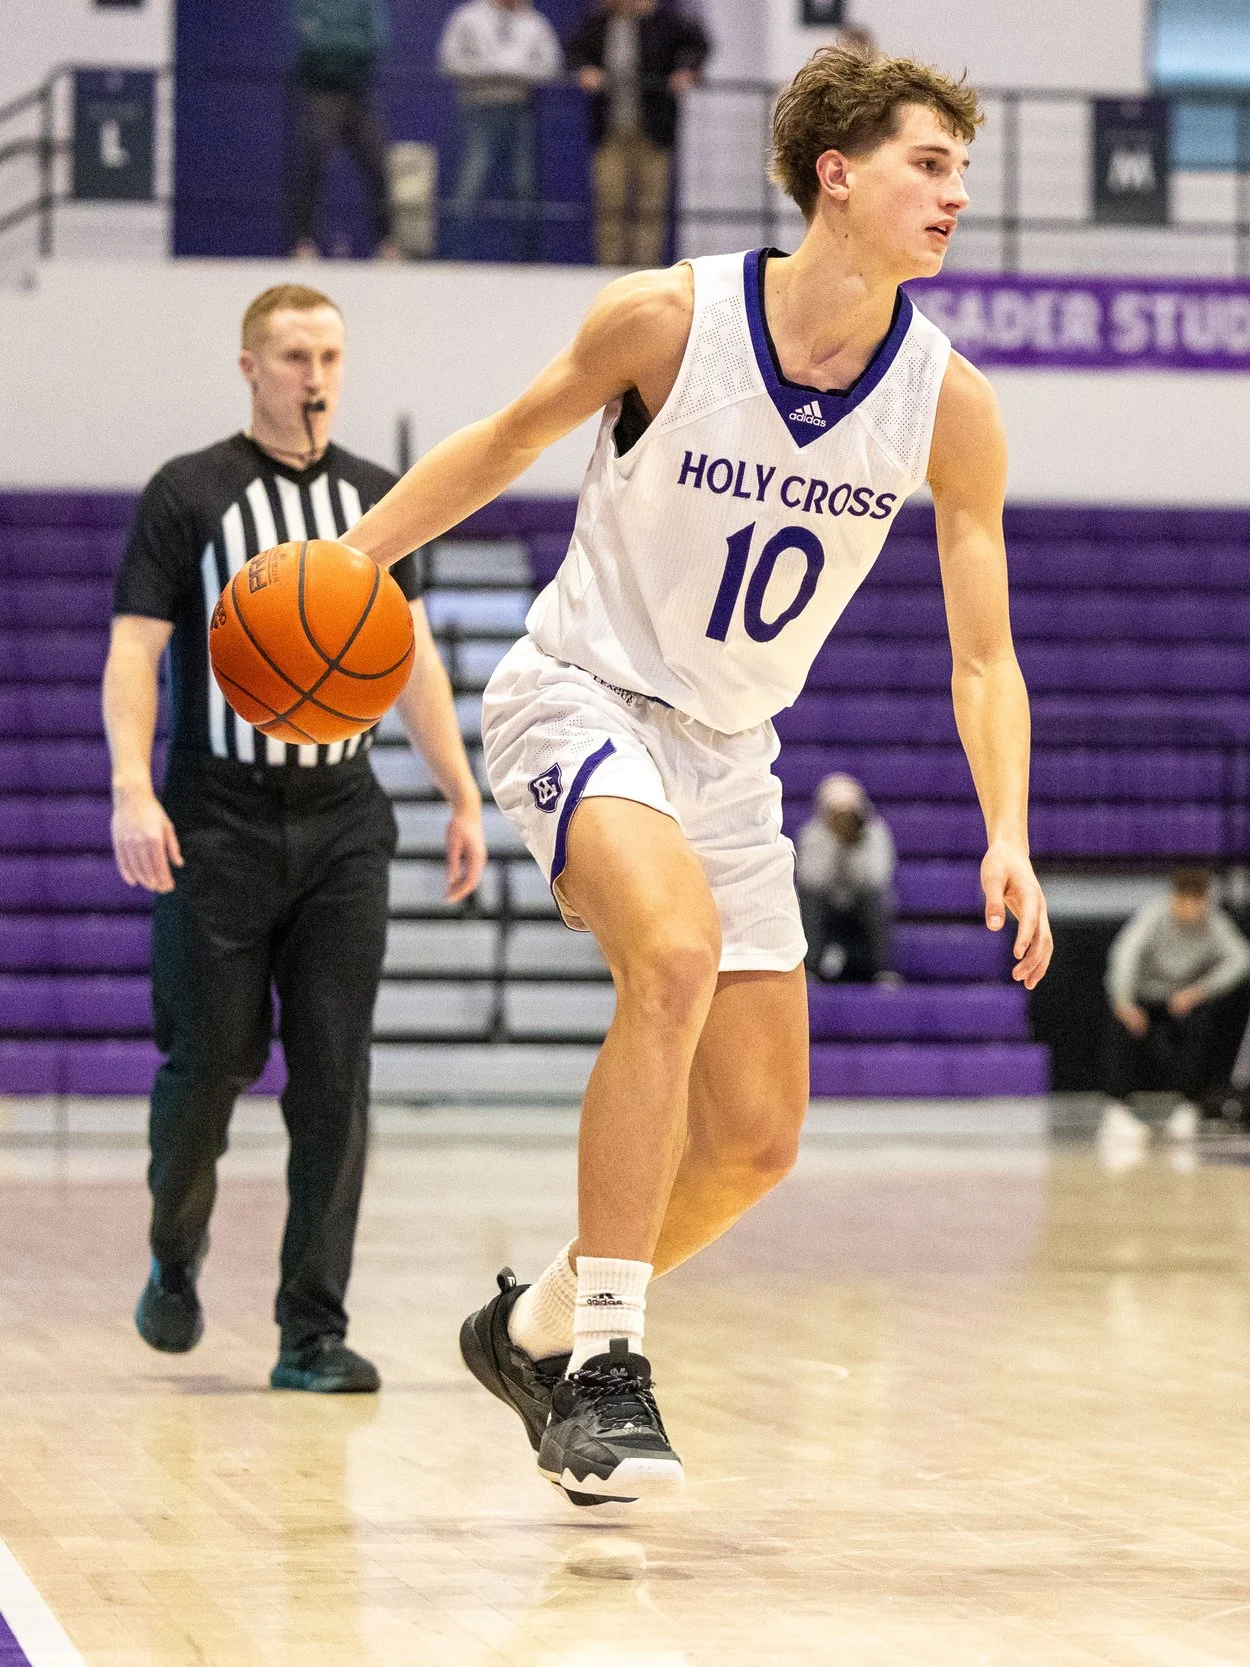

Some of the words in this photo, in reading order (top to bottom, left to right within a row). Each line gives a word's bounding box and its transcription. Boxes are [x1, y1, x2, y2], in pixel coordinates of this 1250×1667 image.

[918, 290, 1102, 355] SADER
[789, 412, 827, 428] adidas
[677, 450, 777, 502] HOLY
[780, 475, 898, 520] CROSS
[705, 520, 826, 643] 10
